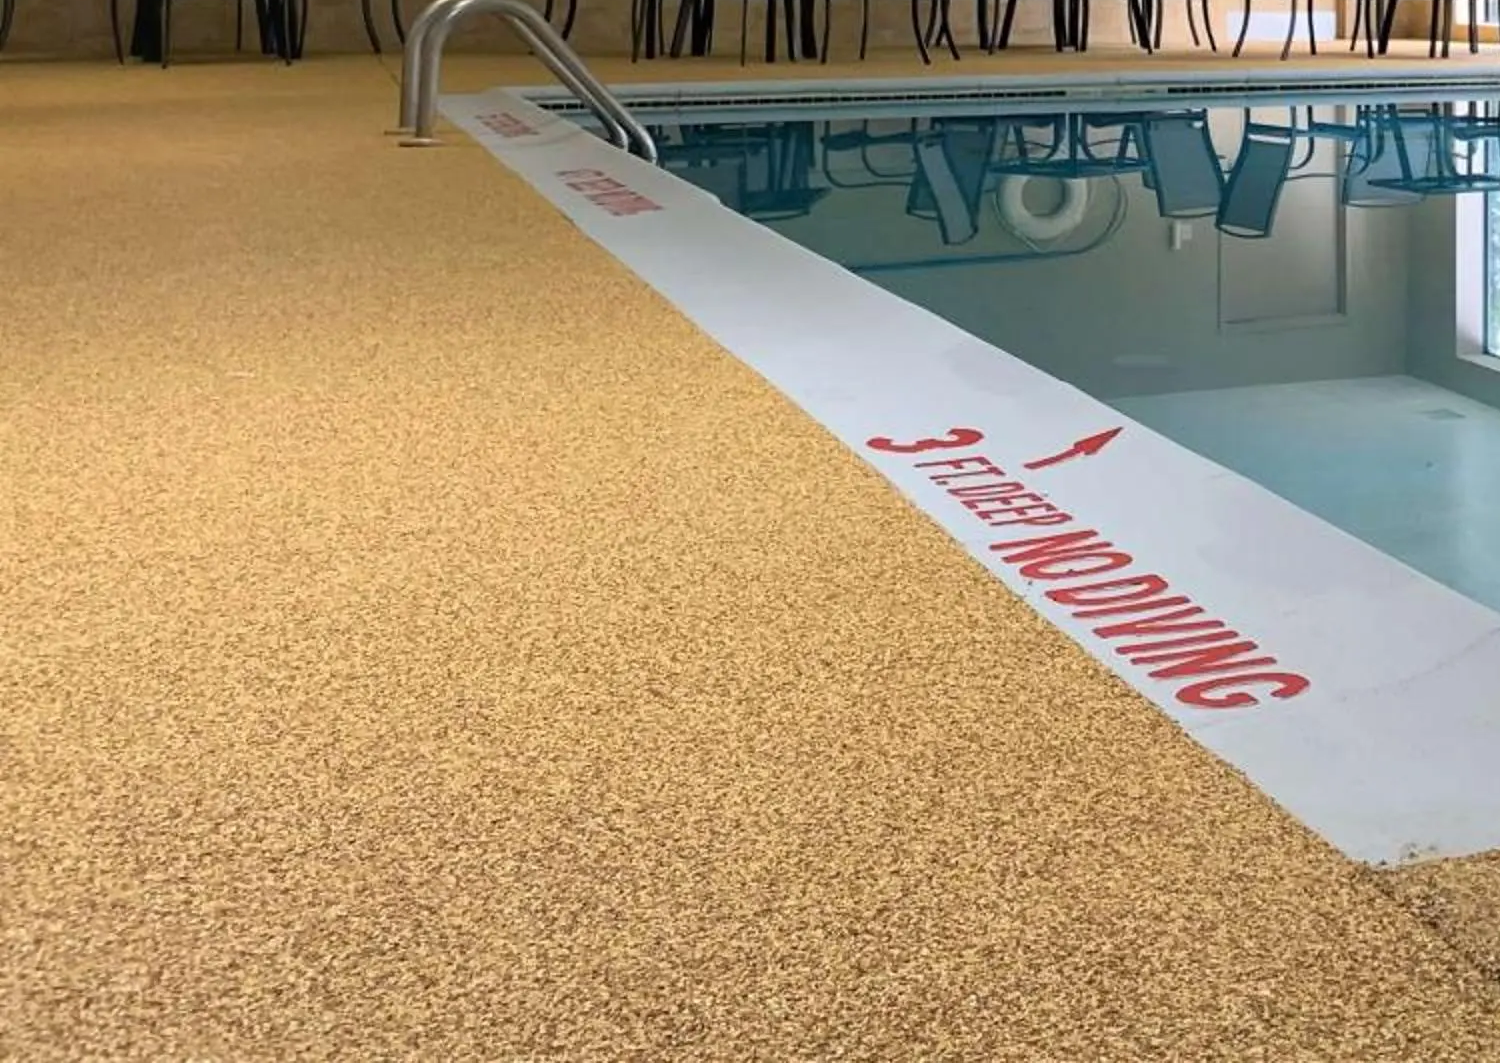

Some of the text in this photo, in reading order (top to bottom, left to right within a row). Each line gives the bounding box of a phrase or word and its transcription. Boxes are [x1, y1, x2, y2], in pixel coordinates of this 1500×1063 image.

[865, 427, 985, 454] 3
[946, 480, 1073, 526] DEEP
[988, 529, 1133, 582] NO
[1044, 573, 1311, 709] DIVING
